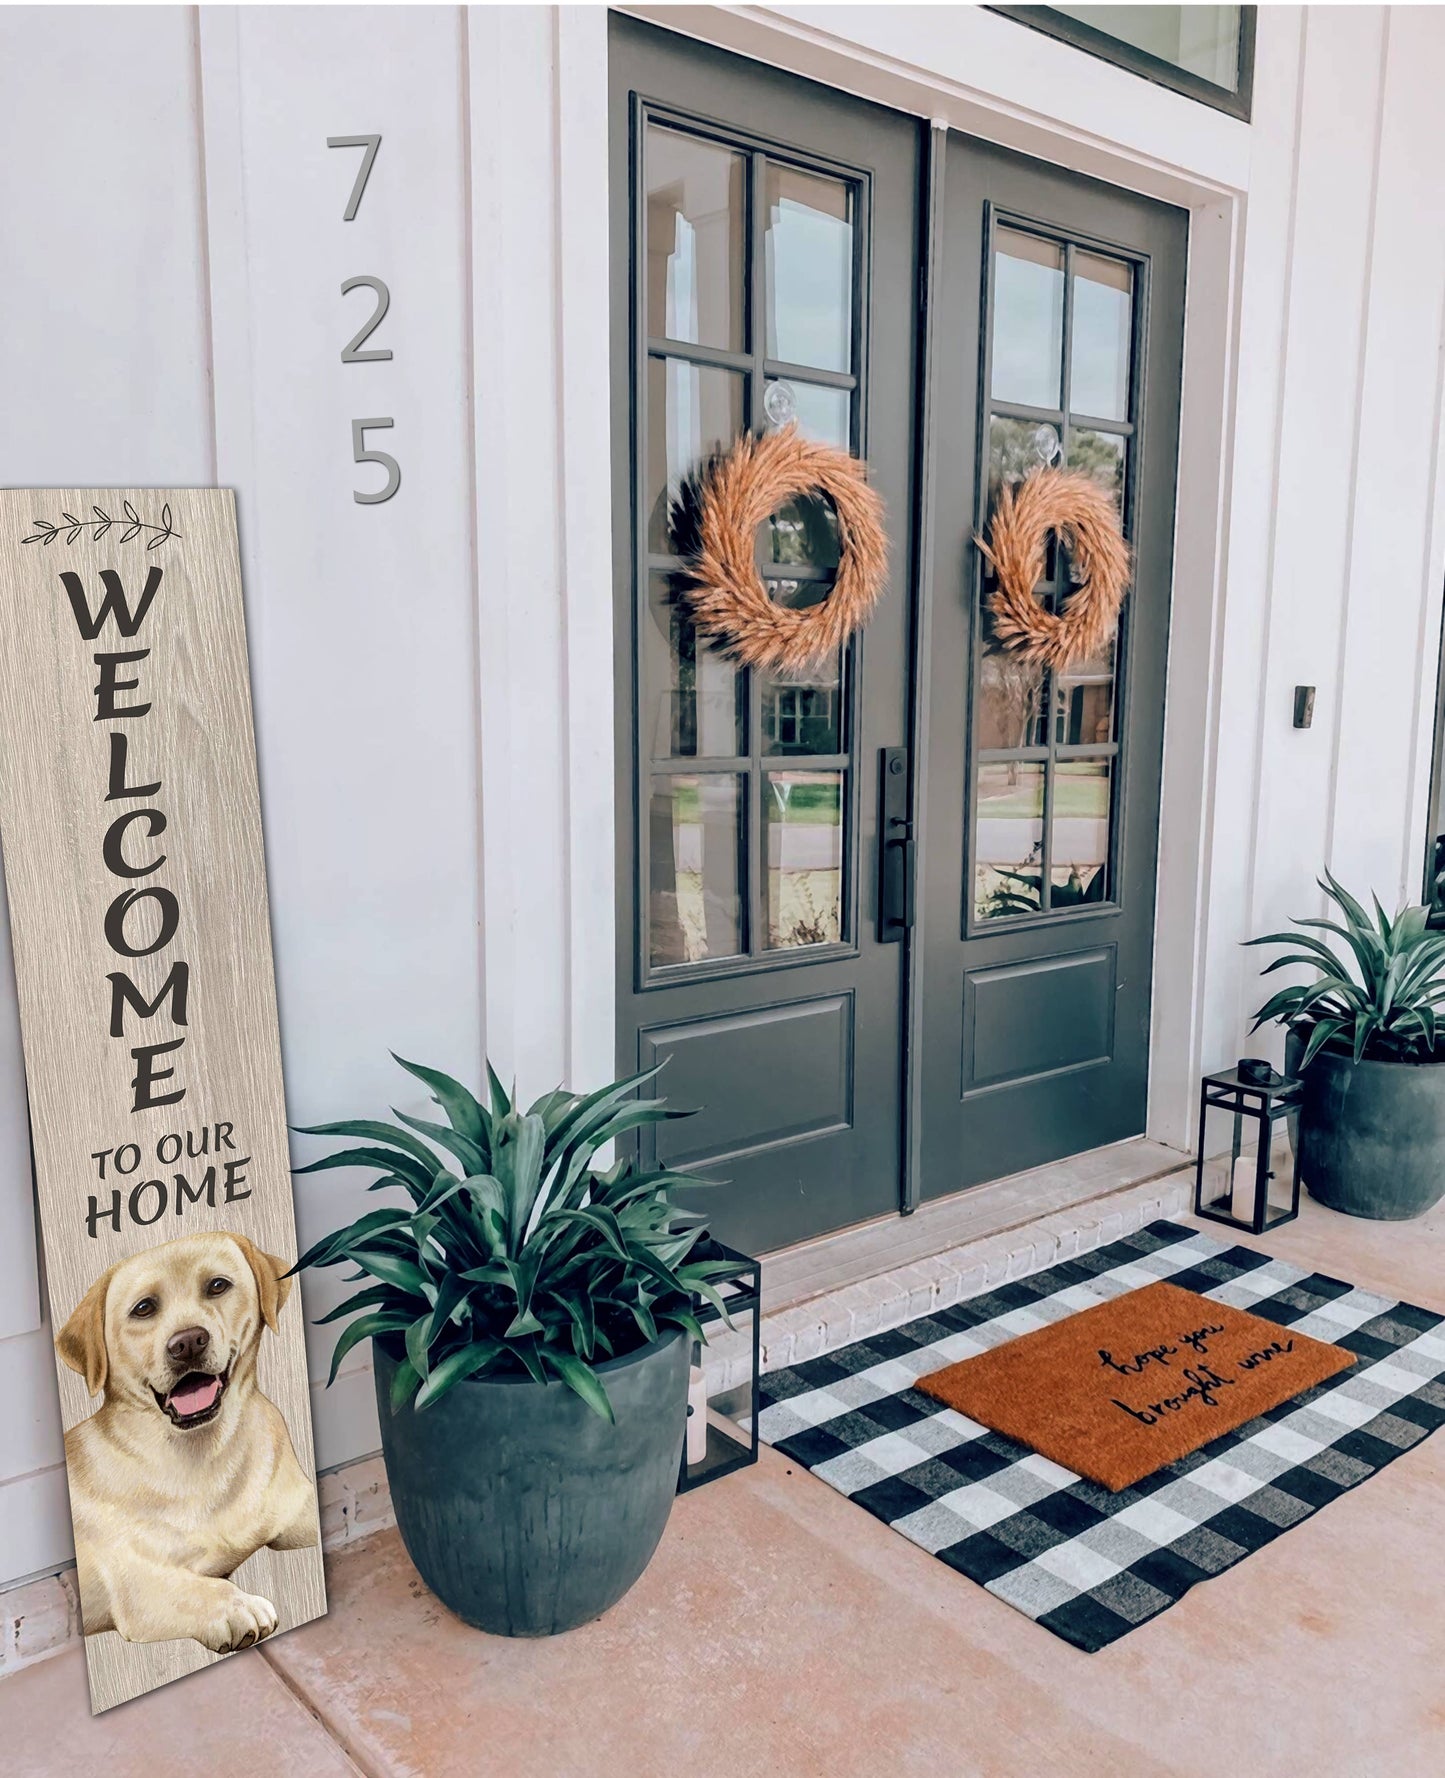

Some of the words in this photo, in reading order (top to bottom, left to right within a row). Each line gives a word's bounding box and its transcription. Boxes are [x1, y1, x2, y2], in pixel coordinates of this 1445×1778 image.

[59, 565, 189, 1112] WELCOME
[91, 1143, 141, 1180] TO
[156, 1121, 236, 1165] OUR
[85, 1156, 252, 1239] HOME
[1098, 1344, 1178, 1376] hope
[1178, 1324, 1225, 1354] you
[1110, 1364, 1236, 1426] brought
[1238, 1339, 1294, 1370] wine
